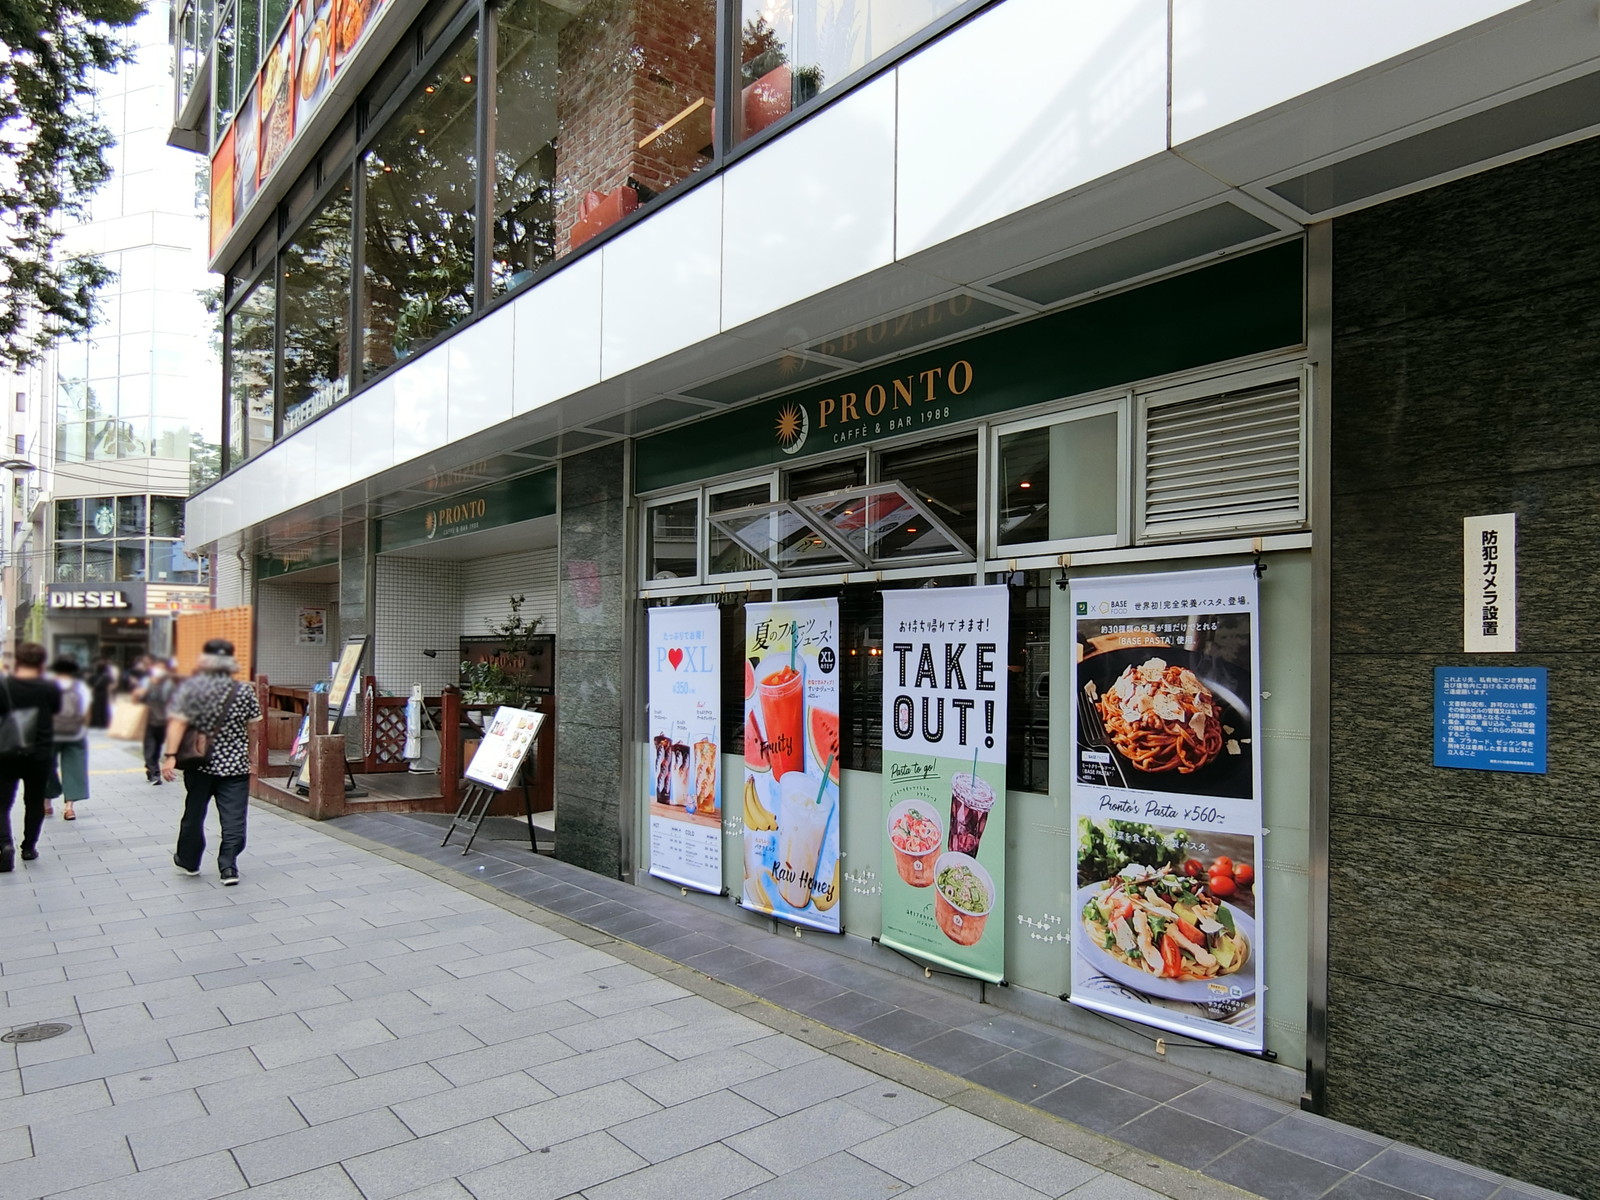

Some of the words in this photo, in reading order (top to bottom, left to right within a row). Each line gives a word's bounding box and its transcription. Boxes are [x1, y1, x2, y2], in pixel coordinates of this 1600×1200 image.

[818, 360, 973, 430] PRONTO
[833, 423, 868, 443] CAFFÈ
[874, 422, 881, 434] &
[889, 416, 912, 430] BAR
[920, 407, 950, 423] 1988
[438, 499, 486, 527] PRONTO
[1482, 530, 1498, 636] 防犯カメラ設置
[51, 590, 127, 608] DIESEL
[1110, 600, 1128, 608] BASE
[752, 618, 816, 652] 夏のフルーツ
[820, 651, 834, 664] XL
[893, 643, 996, 691] TAKE
[893, 695, 995, 749] OUT!
[759, 733, 793, 760] Fruity
[890, 762, 911, 778] Pasta
[911, 764, 922, 774] to
[923, 757, 937, 780] go!
[1099, 795, 1140, 815] Pronto's
[1145, 800, 1178, 818] Pasta
[772, 860, 796, 883] Raw
[799, 870, 835, 903] Honey
